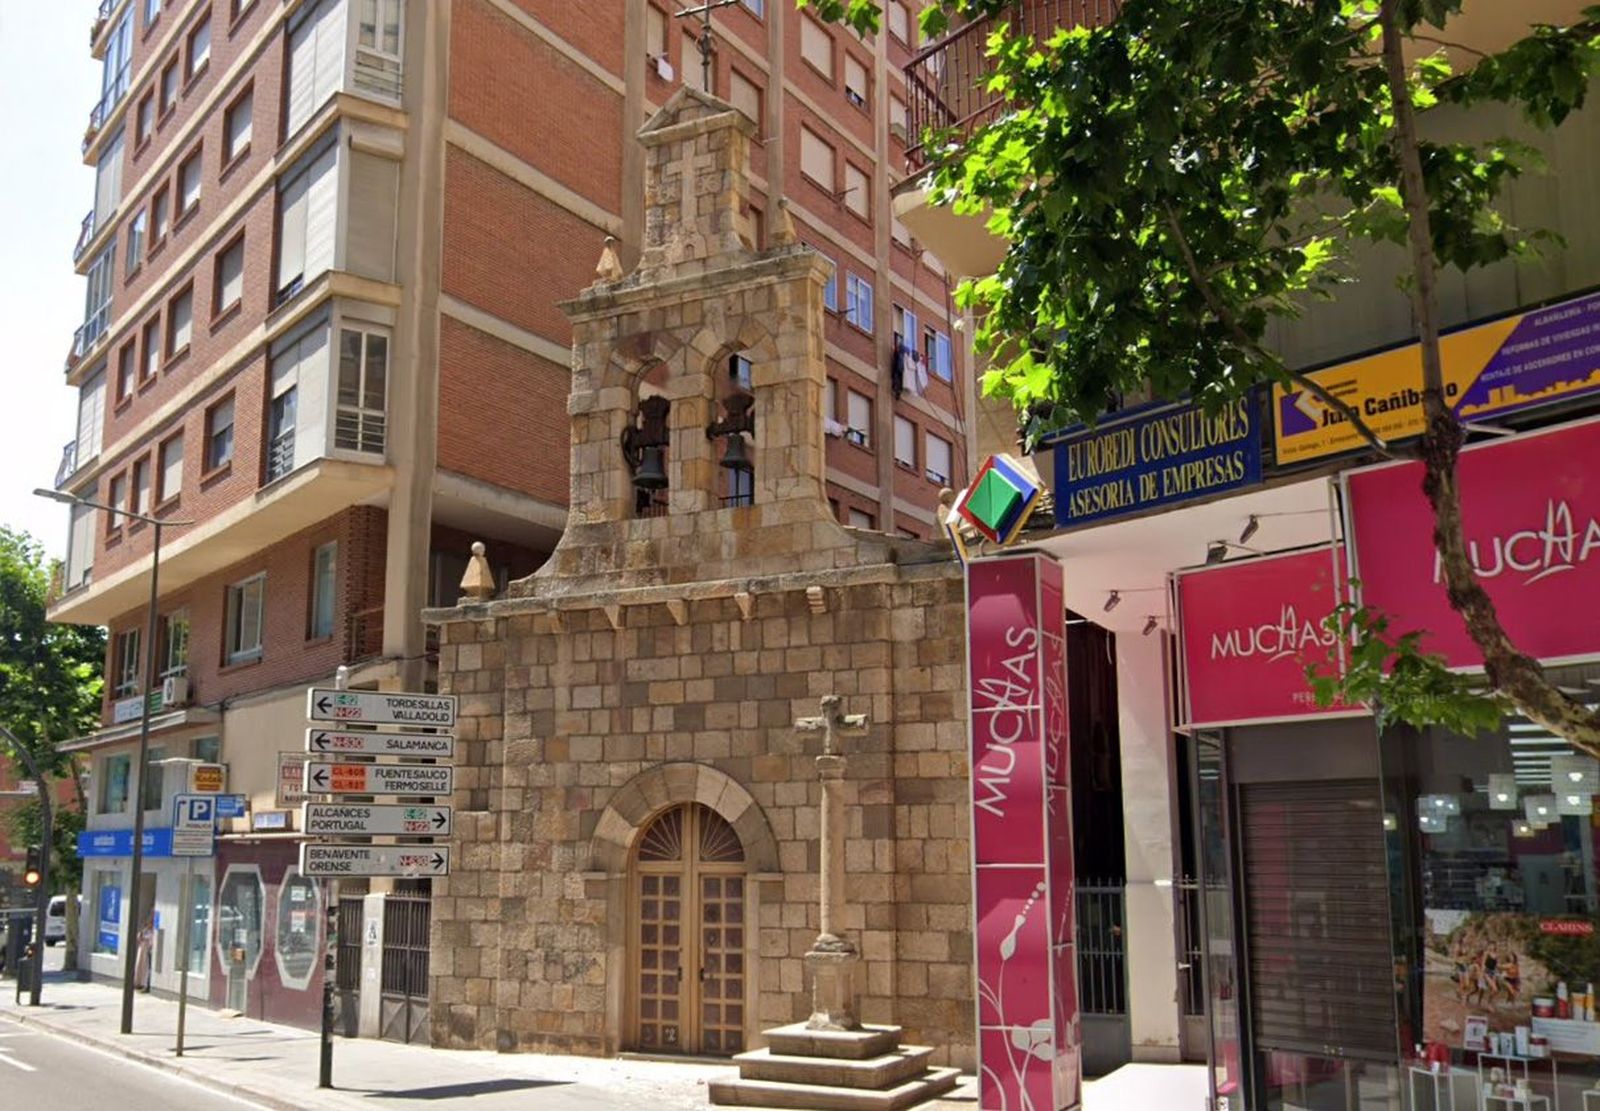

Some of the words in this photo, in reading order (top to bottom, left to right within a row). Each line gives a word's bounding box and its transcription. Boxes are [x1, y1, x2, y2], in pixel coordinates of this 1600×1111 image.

[1068, 427, 1137, 482] EUROBEDI
[1141, 396, 1250, 464] CONSULTORES
[1068, 479, 1134, 518] ASESORIA
[1139, 473, 1159, 503] DE
[1163, 450, 1245, 497] EMPRESAS
[386, 698, 451, 710] TORDESILLAS
[392, 710, 450, 722] VALLADOLID
[975, 626, 1038, 817] MUCHAS
[386, 739, 448, 751] SALAMANCA
[375, 768, 447, 780] FUENTESAUCO
[384, 780, 447, 791] FERMOSELLE
[192, 801, 208, 819] P
[311, 819, 366, 831] PORTUGAL
[309, 848, 370, 860] BENAVENTE
[309, 860, 352, 872] ORENSE
